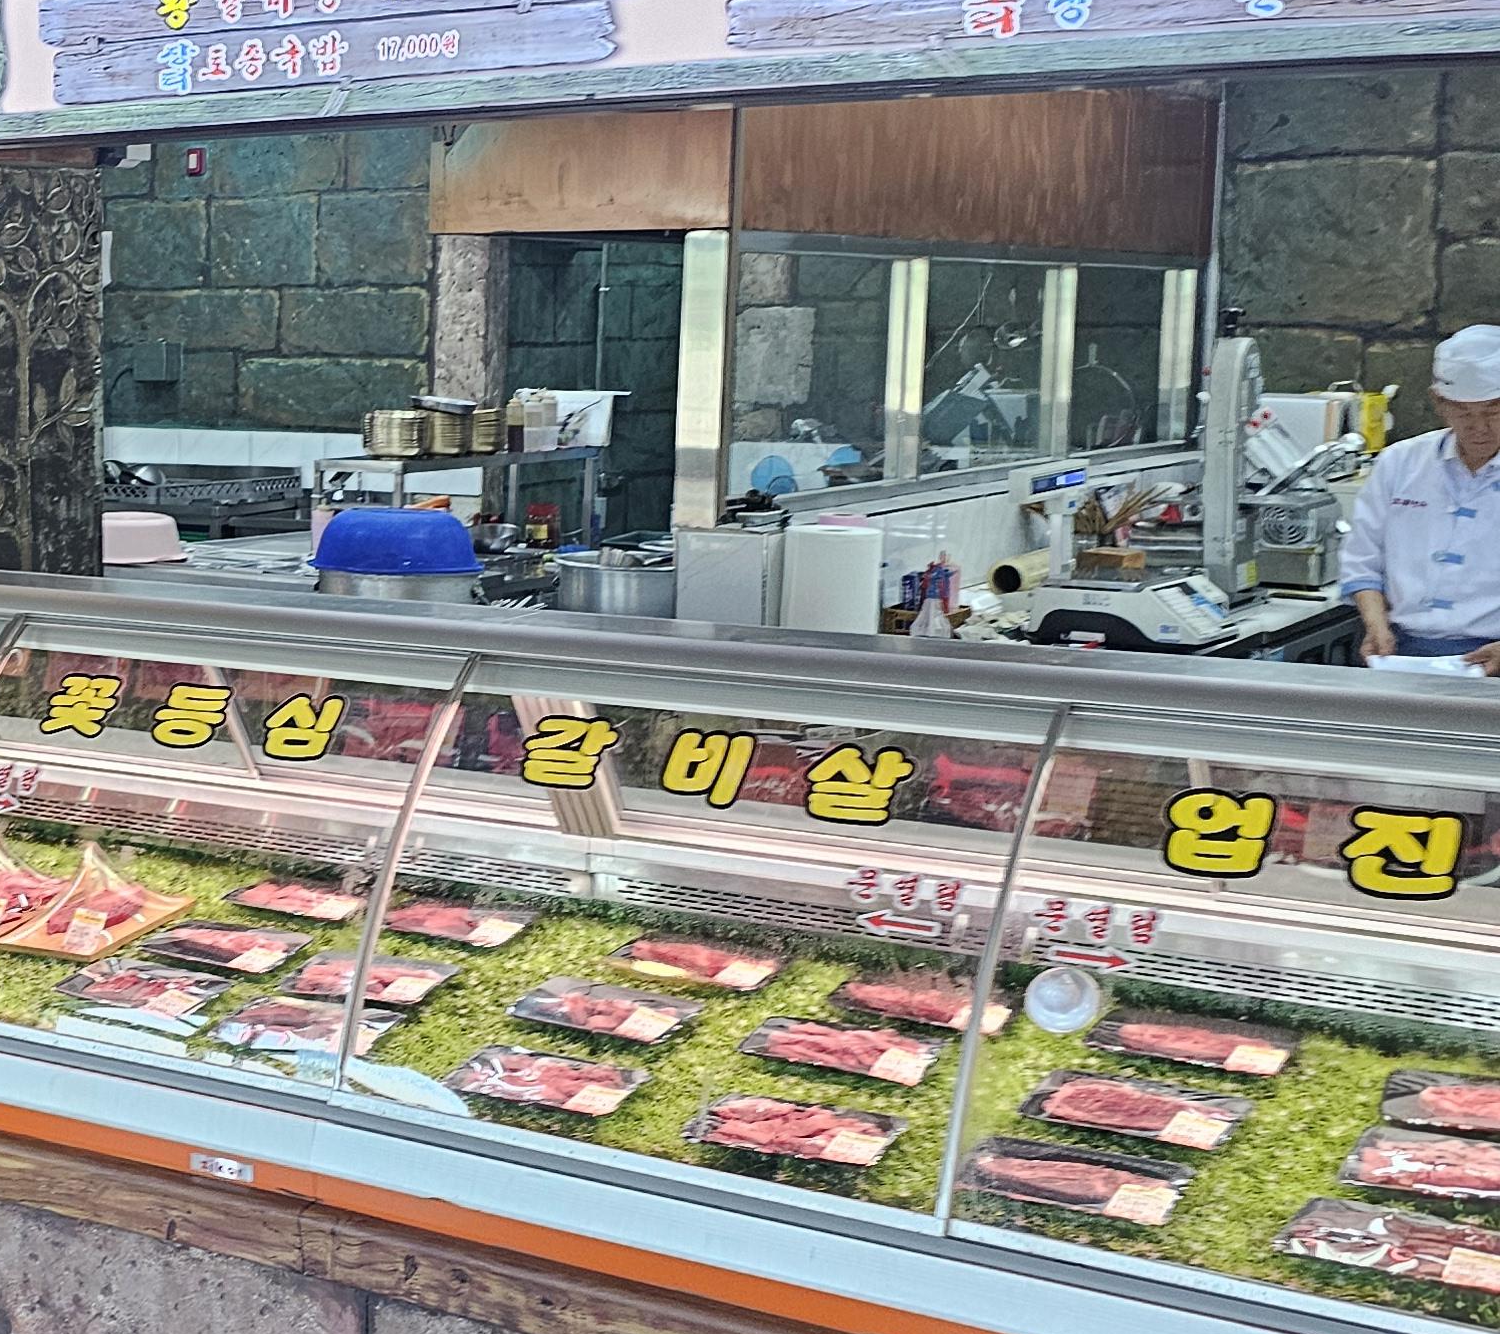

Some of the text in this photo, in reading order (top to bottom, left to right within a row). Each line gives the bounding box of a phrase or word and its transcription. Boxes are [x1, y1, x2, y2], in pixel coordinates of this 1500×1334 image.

[200, 33, 346, 78] 토종국밥
[379, 32, 457, 58] 17,000원
[40, 673, 348, 760] 꽃등심
[523, 715, 915, 825] 갈비살
[1162, 787, 1466, 900] 업진
